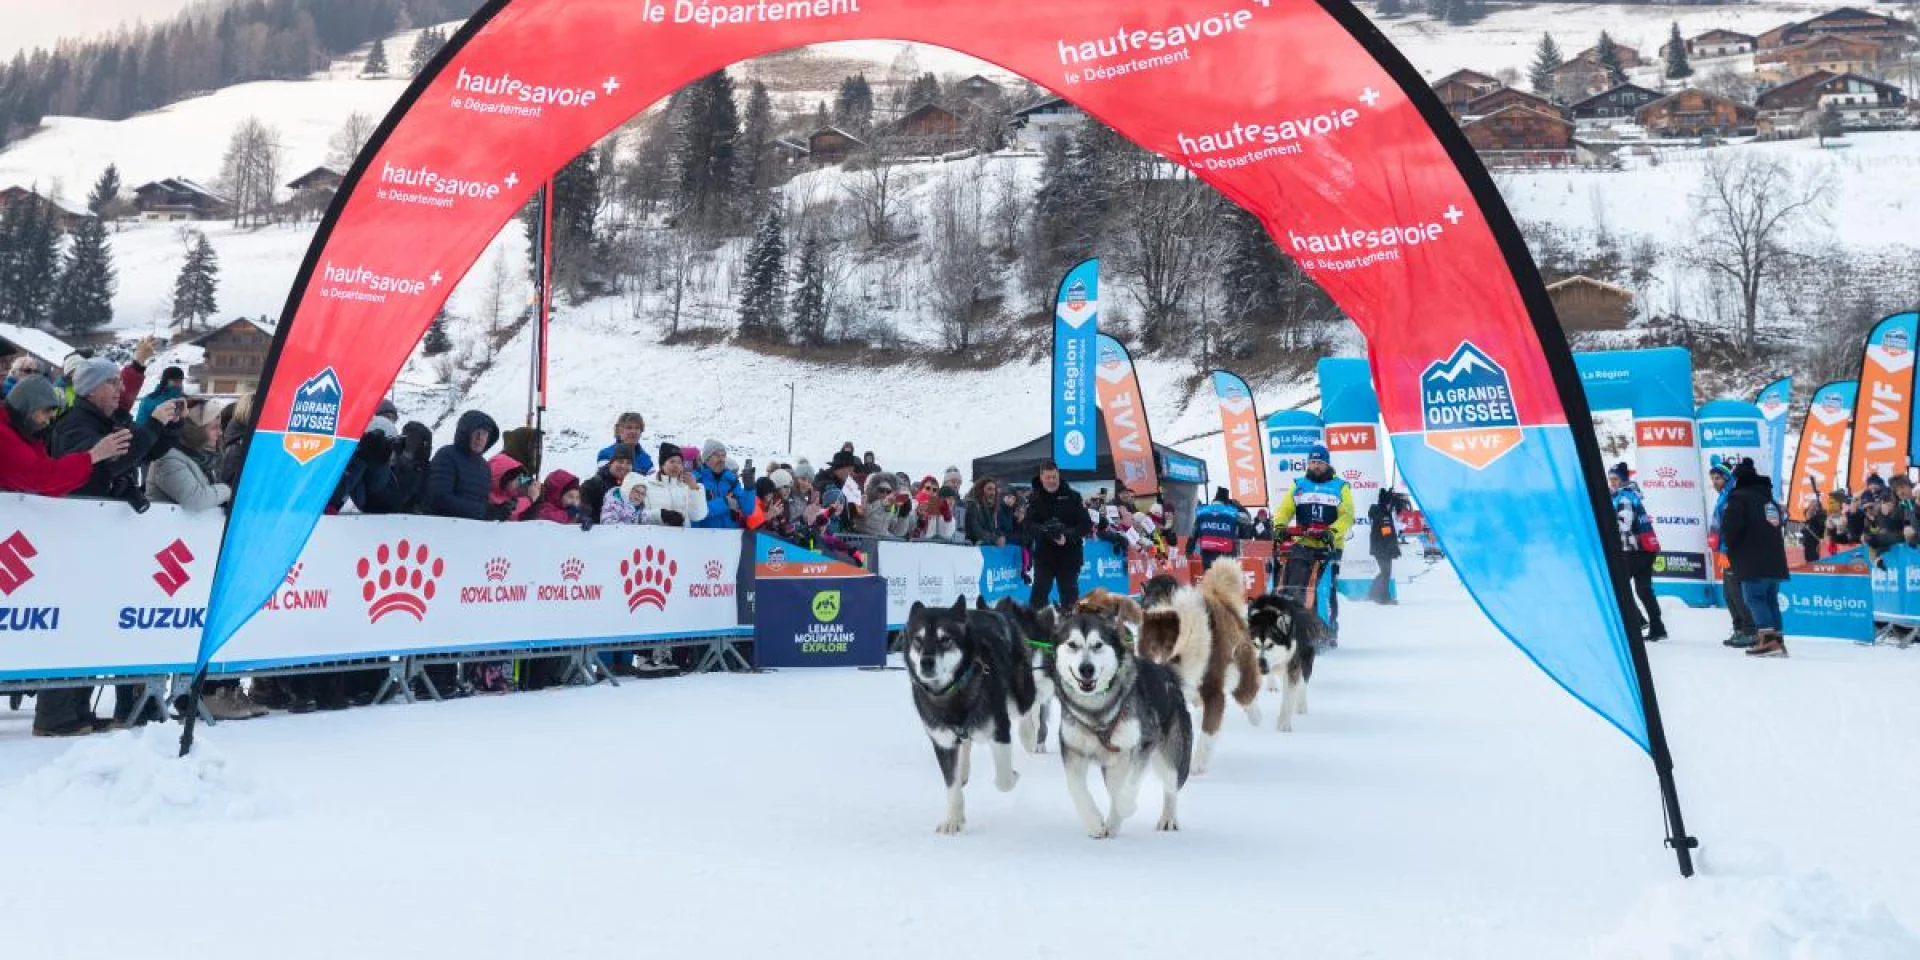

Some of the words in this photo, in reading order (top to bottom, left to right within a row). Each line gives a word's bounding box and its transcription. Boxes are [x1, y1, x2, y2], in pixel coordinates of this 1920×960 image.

[642, 0, 664, 23] le
[674, 0, 860, 29] Département
[1058, 9, 1253, 65] hautesavoie
[1064, 68, 1080, 85] le
[1084, 48, 1191, 83] Département
[456, 67, 595, 107] hautesavoie
[450, 96, 463, 109] le
[464, 98, 543, 118] Département
[1177, 107, 1360, 156] hautesavoie
[1206, 142, 1303, 172] Département
[381, 161, 500, 199] hautesavoie
[376, 188, 386, 199] le
[1288, 222, 1444, 253] hautesavoie
[1302, 259, 1315, 270] le
[323, 261, 425, 296] hautesavoie
[1064, 339, 1079, 401] Région
[1582, 370, 1594, 380] La
[1427, 390, 1446, 404] LA
[1447, 385, 1508, 404] GRANDE
[1064, 404, 1077, 426] La
[1110, 391, 1143, 453] VVF
[1428, 400, 1513, 425] ODYSSÉE
[1866, 381, 1904, 451] VVF
[1341, 432, 1369, 445] VVF
[1653, 426, 1686, 441] VVF
[1231, 422, 1256, 472] VVF
[1289, 458, 1307, 472] ici
[1656, 516, 1700, 526] SUZUKI
[283, 590, 328, 609] CANIN
[460, 585, 494, 604] ROYAL
[495, 584, 528, 602] CANIN
[537, 584, 569, 602] ROYAL
[570, 584, 602, 601] CANIN
[689, 583, 712, 598] ROYAL
[712, 583, 734, 597] CANIN
[1792, 594, 1810, 606] La
[1813, 594, 1867, 610] Région
[118, 607, 206, 630] SUZUK
[808, 623, 844, 633] LEMAN
[794, 633, 855, 643] MOUNTAINS
[802, 642, 848, 652] EXPLORE
